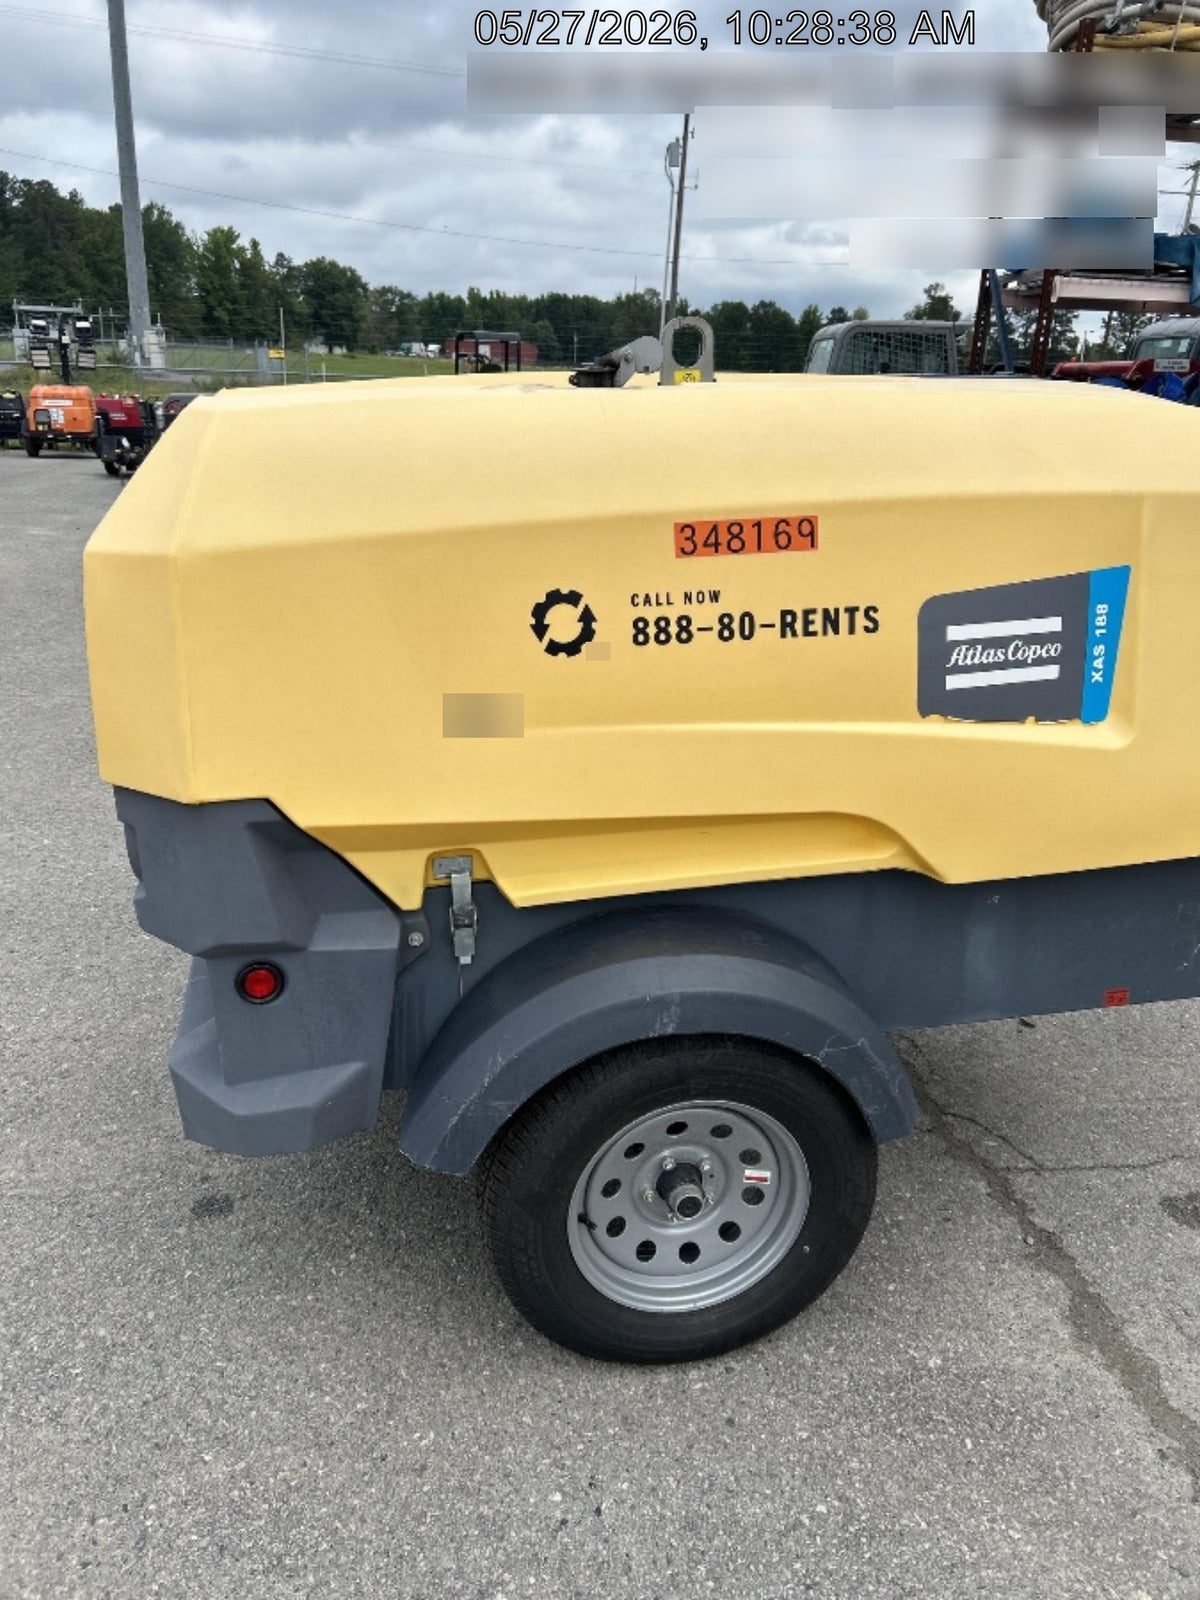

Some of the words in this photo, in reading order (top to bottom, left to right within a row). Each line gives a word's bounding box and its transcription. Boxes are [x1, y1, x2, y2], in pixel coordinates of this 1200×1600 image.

[679, 518, 816, 556] 348169
[630, 592, 674, 607] CALL
[683, 590, 721, 605] NOW
[632, 605, 880, 646] 888-80-RENTS
[1095, 603, 1109, 637] 188
[1091, 644, 1106, 683] XAS
